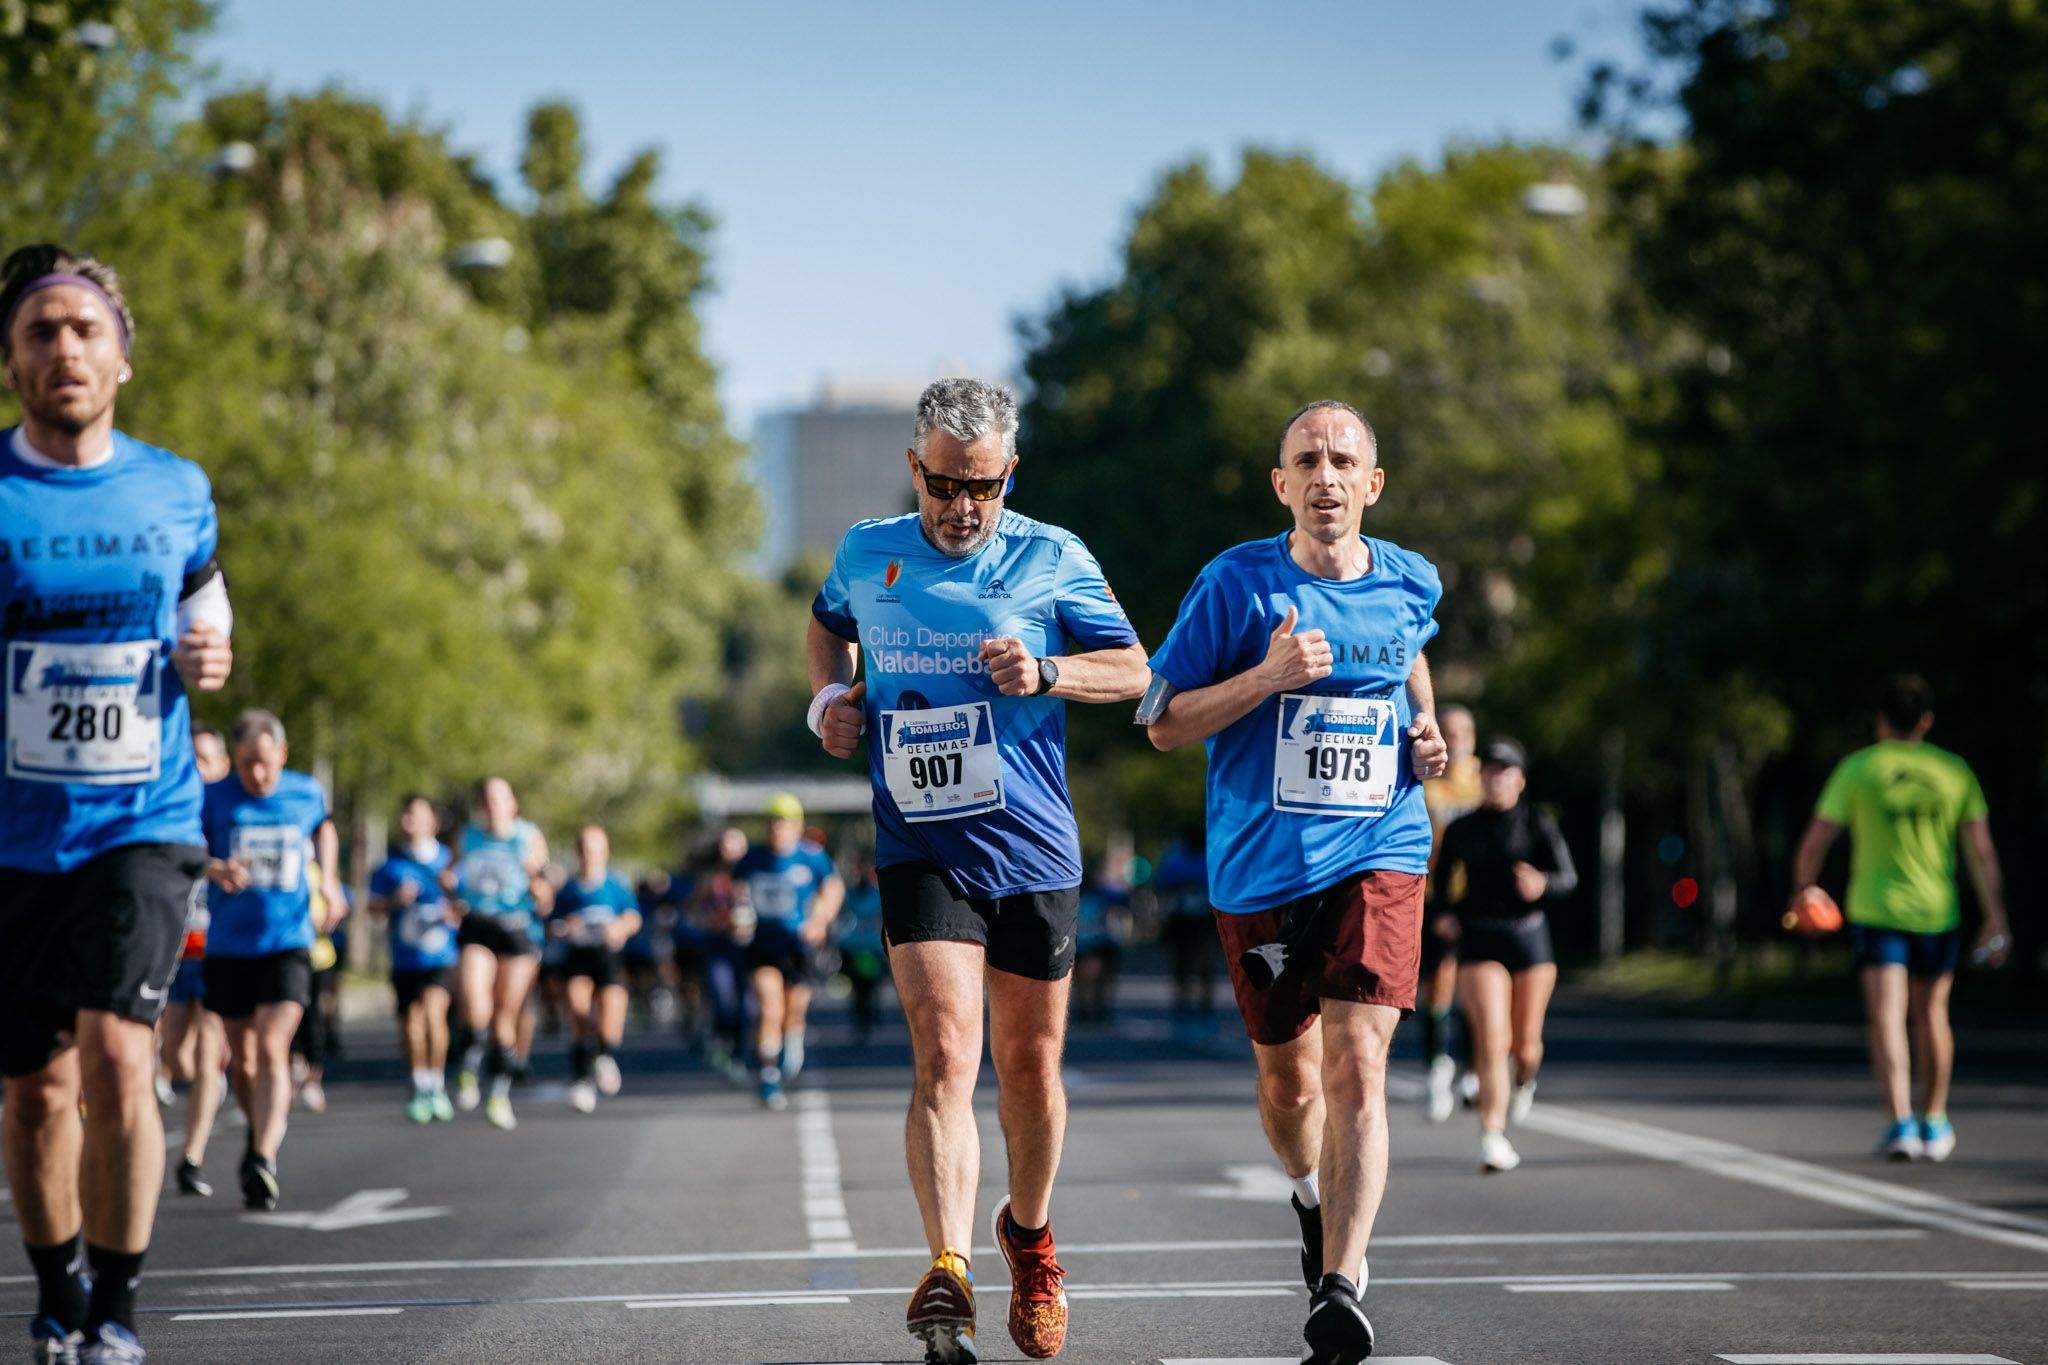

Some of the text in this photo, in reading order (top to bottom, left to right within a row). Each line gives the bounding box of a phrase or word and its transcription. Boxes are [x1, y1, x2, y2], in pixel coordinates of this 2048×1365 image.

[869, 626, 1012, 651] Club Deporti
[1338, 644, 1405, 667] IMAS
[50, 703, 122, 741] 280
[910, 721, 967, 735] BOMBEROS
[1323, 714, 1377, 726] BOMBEROS
[908, 739, 968, 754] DECIMAS
[1315, 733, 1374, 746] DECIMAS
[910, 753, 963, 789] 907
[1305, 746, 1371, 782] 1973
